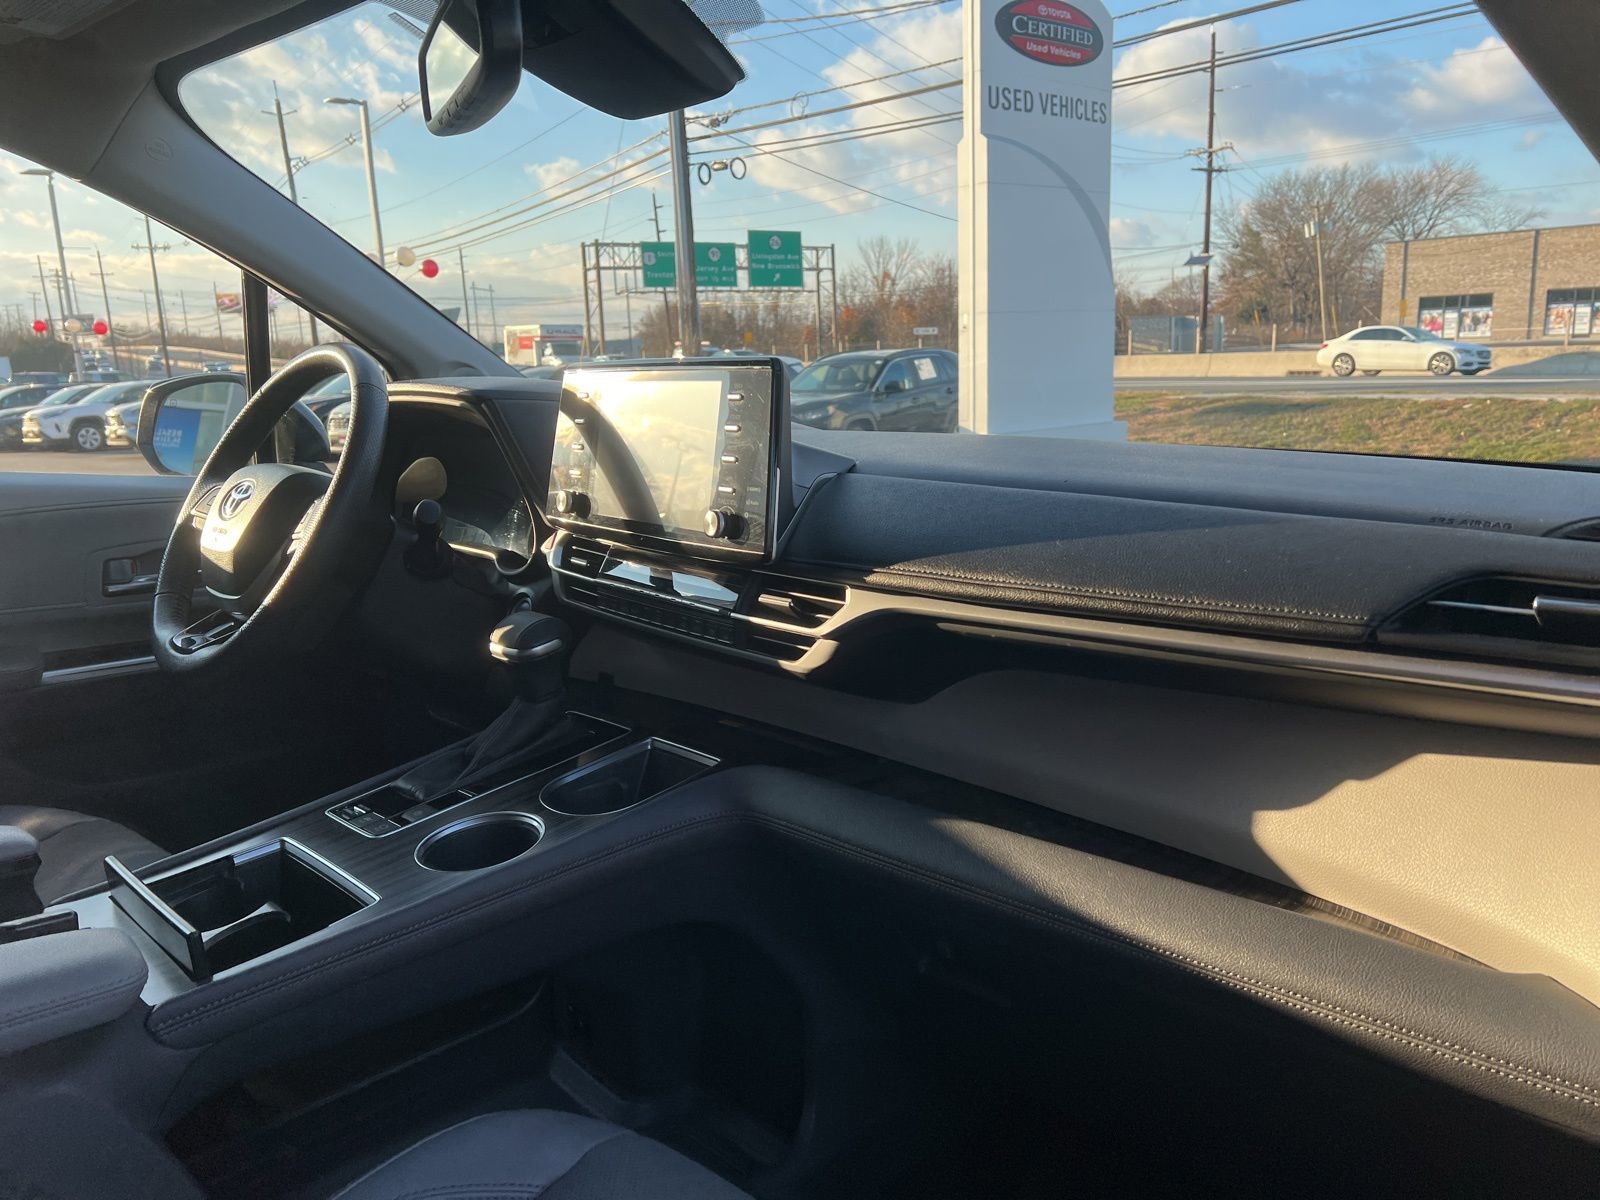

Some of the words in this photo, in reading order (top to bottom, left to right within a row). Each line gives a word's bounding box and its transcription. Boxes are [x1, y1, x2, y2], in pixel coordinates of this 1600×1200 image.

[1047, 8, 1071, 19] TOYOTA
[1012, 15, 1093, 45] CERTIFIED
[1026, 41, 1049, 54] Used
[1050, 46, 1081, 59] Vehicles
[988, 85, 1033, 113] USED
[1039, 92, 1107, 124] VEHICLES
[1457, 518, 1513, 530] AIRBAG
